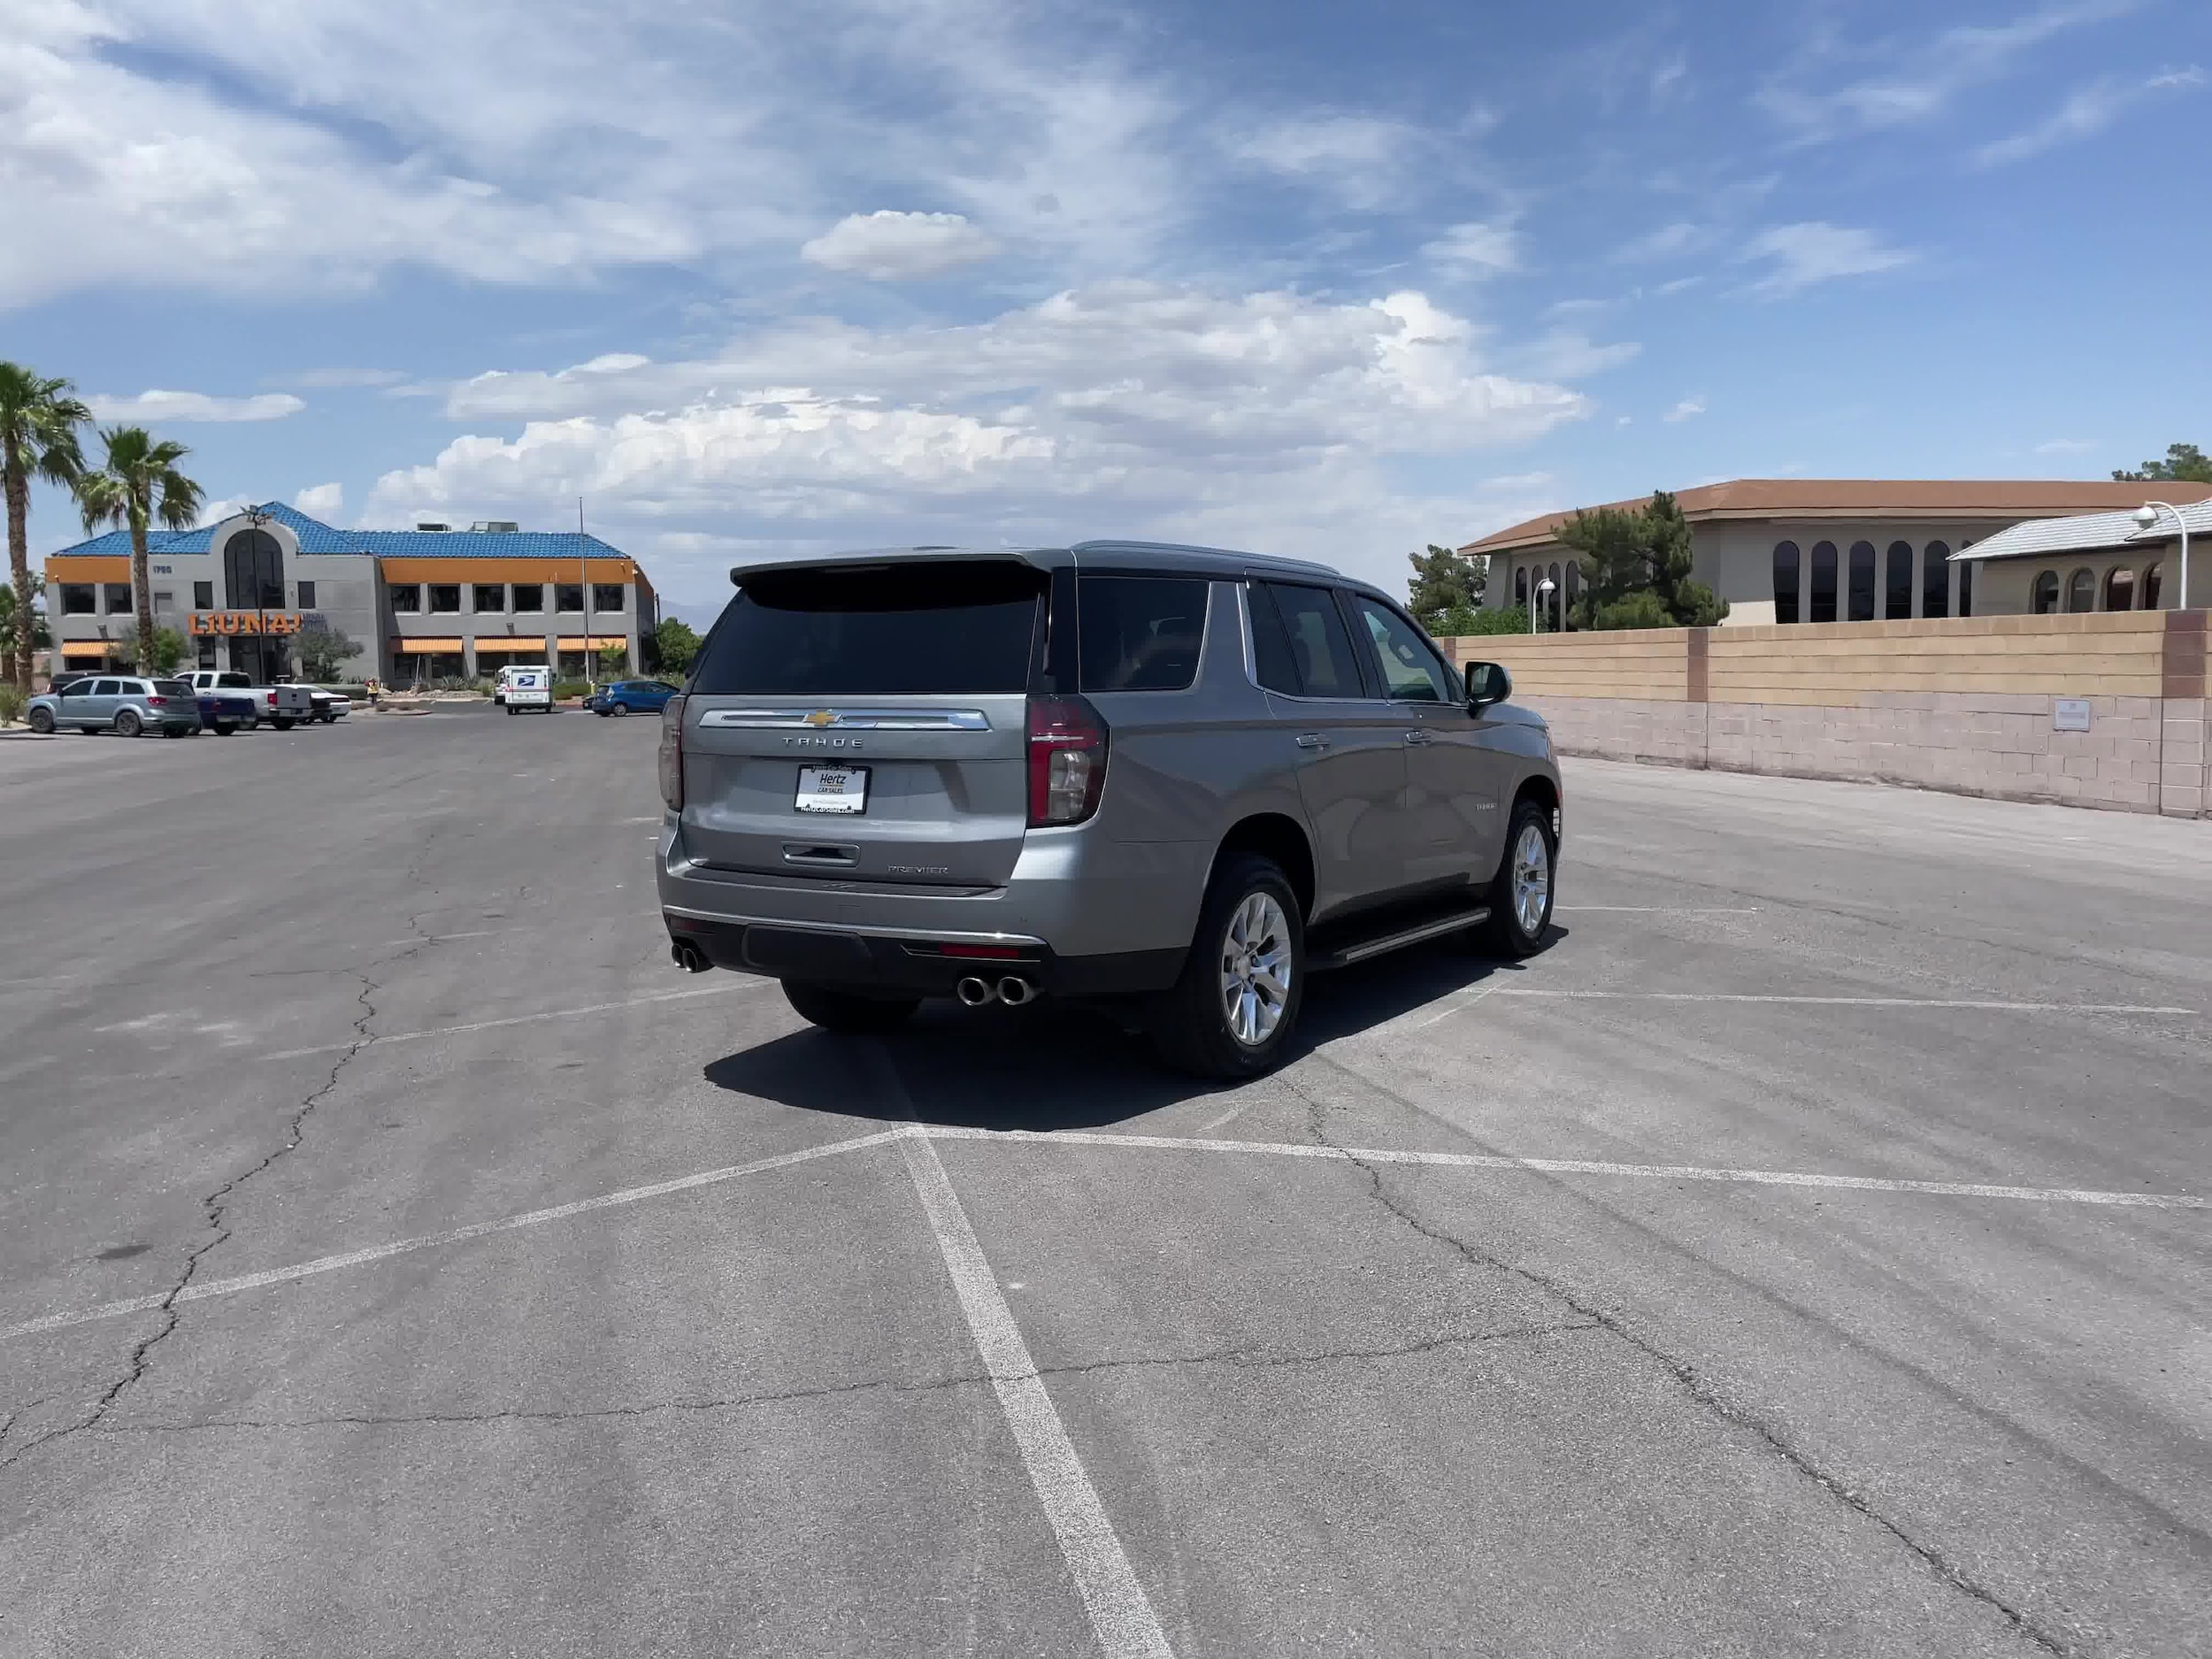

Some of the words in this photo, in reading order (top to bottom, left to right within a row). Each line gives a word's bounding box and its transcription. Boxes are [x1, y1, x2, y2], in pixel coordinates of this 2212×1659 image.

[782, 737, 864, 748] TAHOE
[820, 773, 847, 784] Hertz
[887, 865, 949, 874] PREMIER
